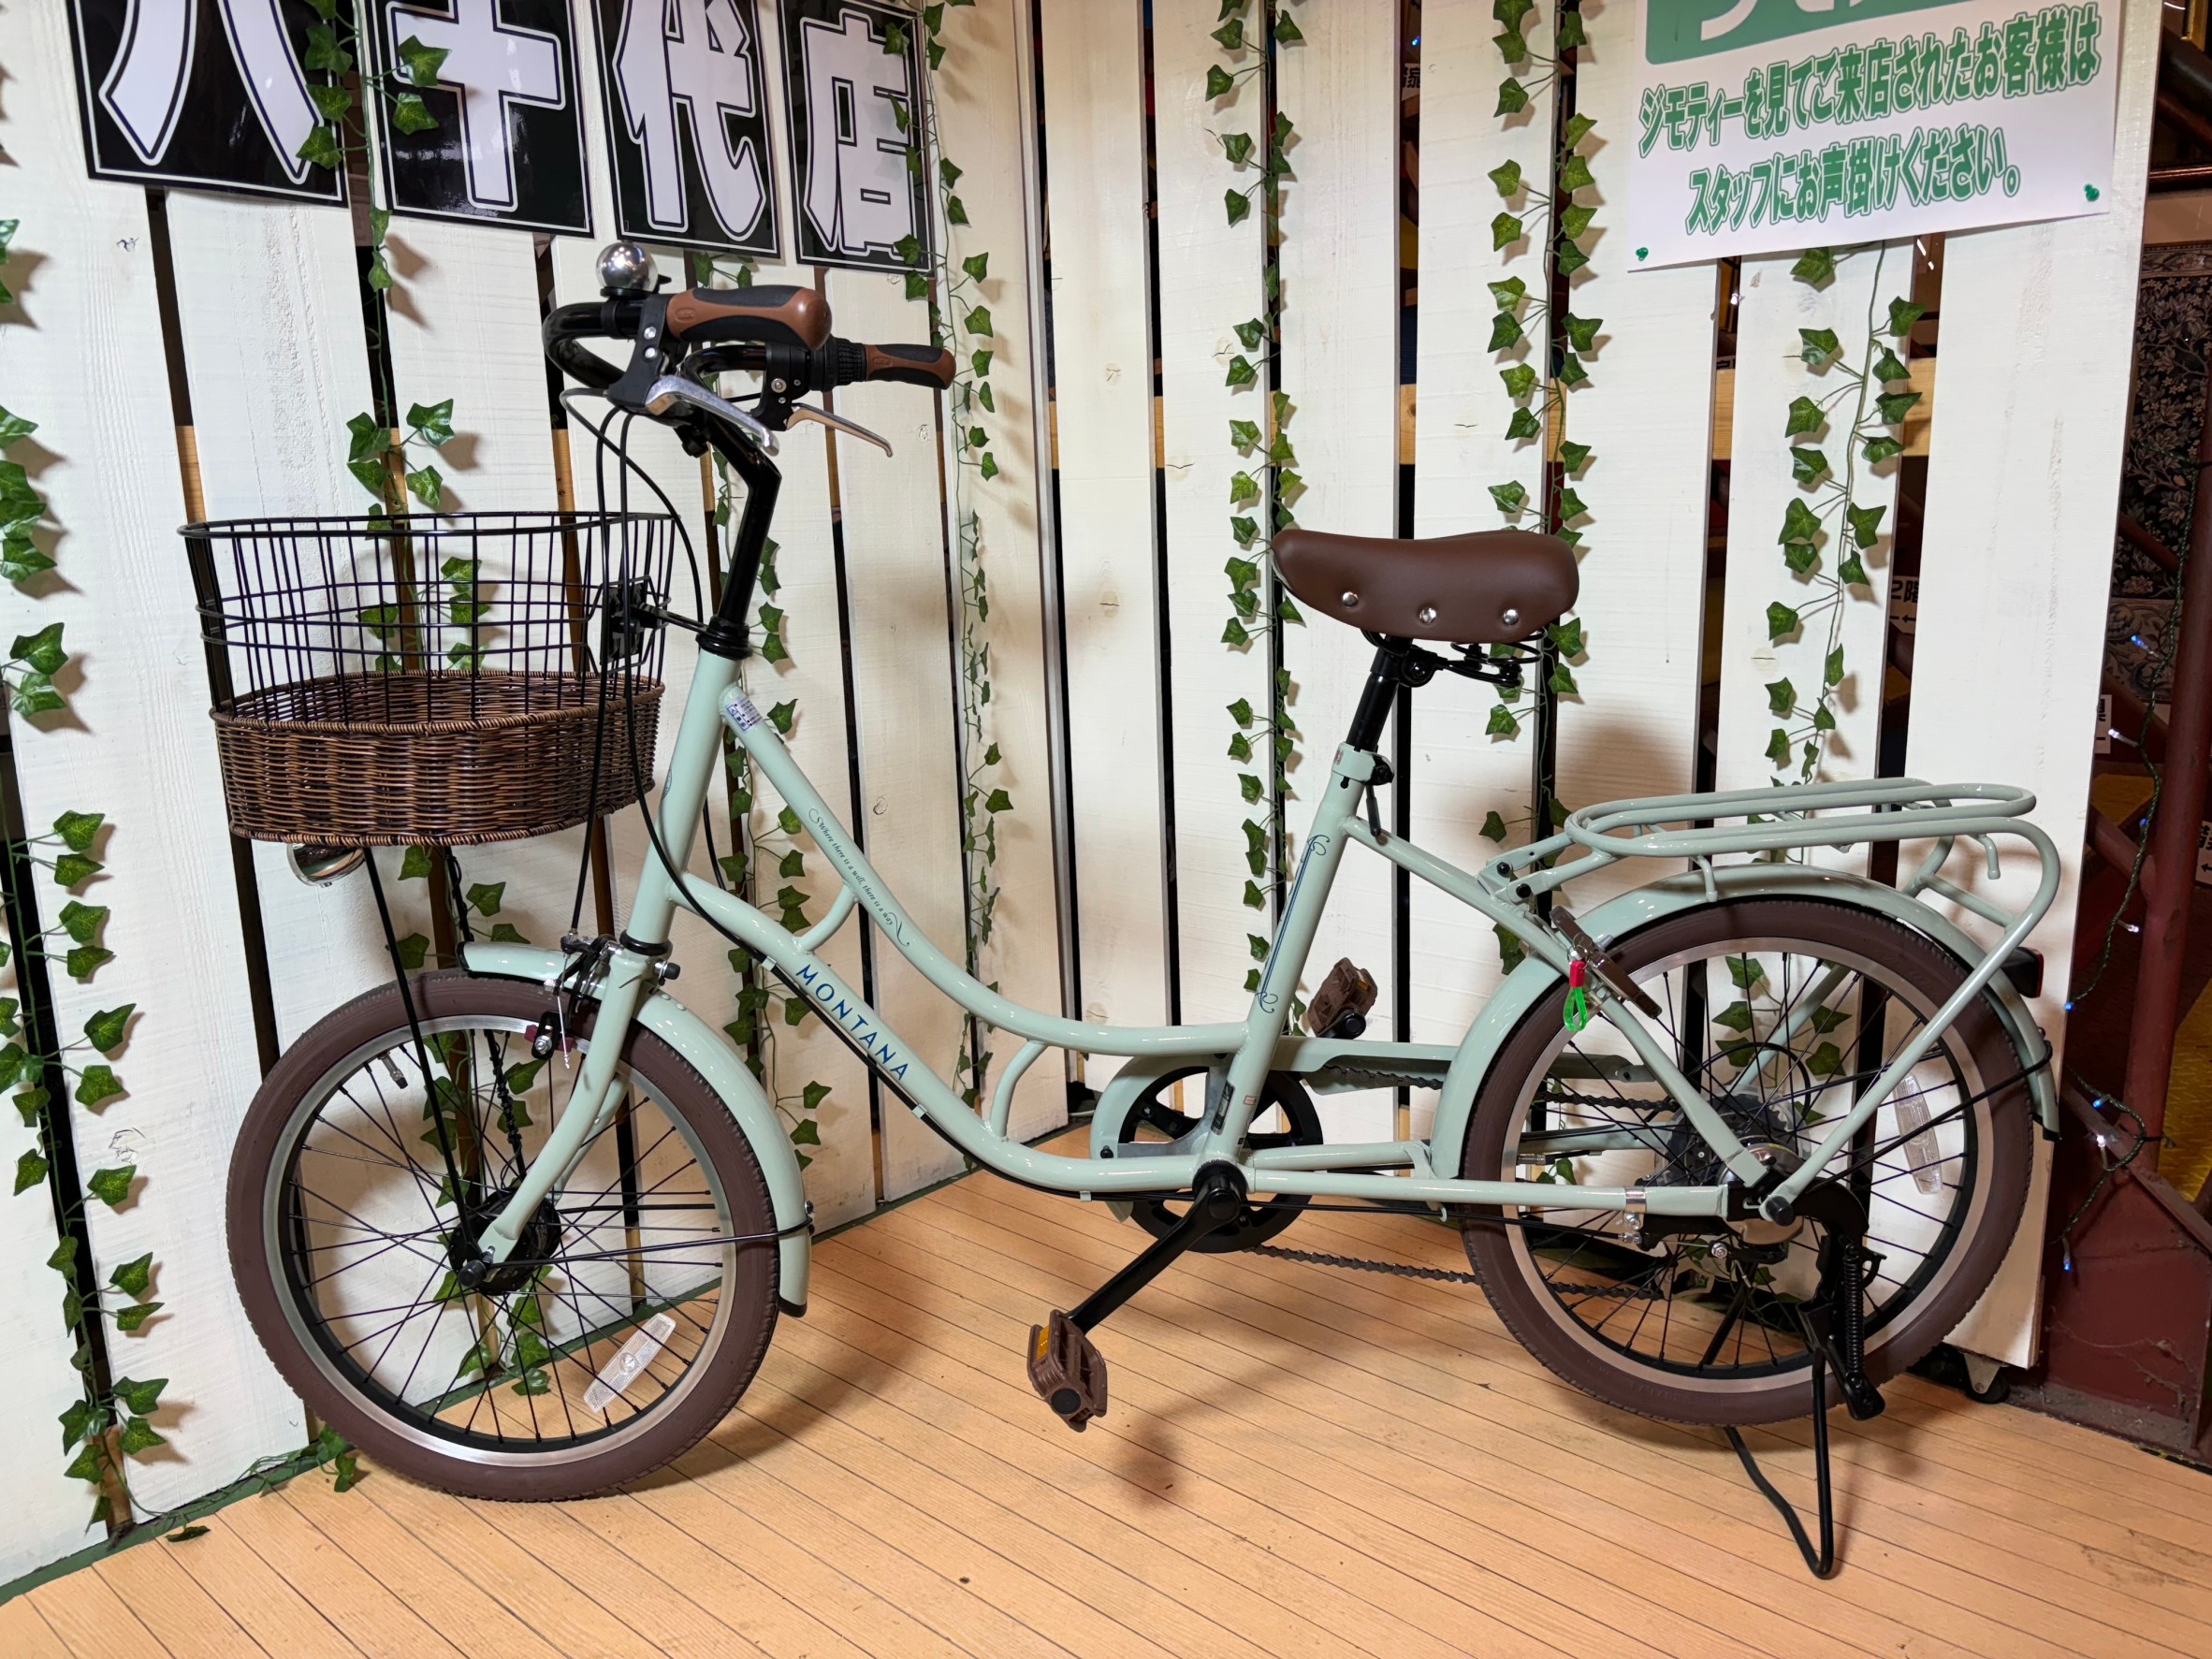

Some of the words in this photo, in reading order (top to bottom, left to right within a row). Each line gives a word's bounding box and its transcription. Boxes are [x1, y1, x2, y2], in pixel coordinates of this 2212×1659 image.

[1638, 2, 2103, 158] ジモティーを見てご来店されたお客様は
[1685, 123, 2020, 236] スタッフにお声掛けください。
[832, 843, 846, 858] there
[863, 885, 876, 900] there
[795, 964, 909, 1081] MONTANA
